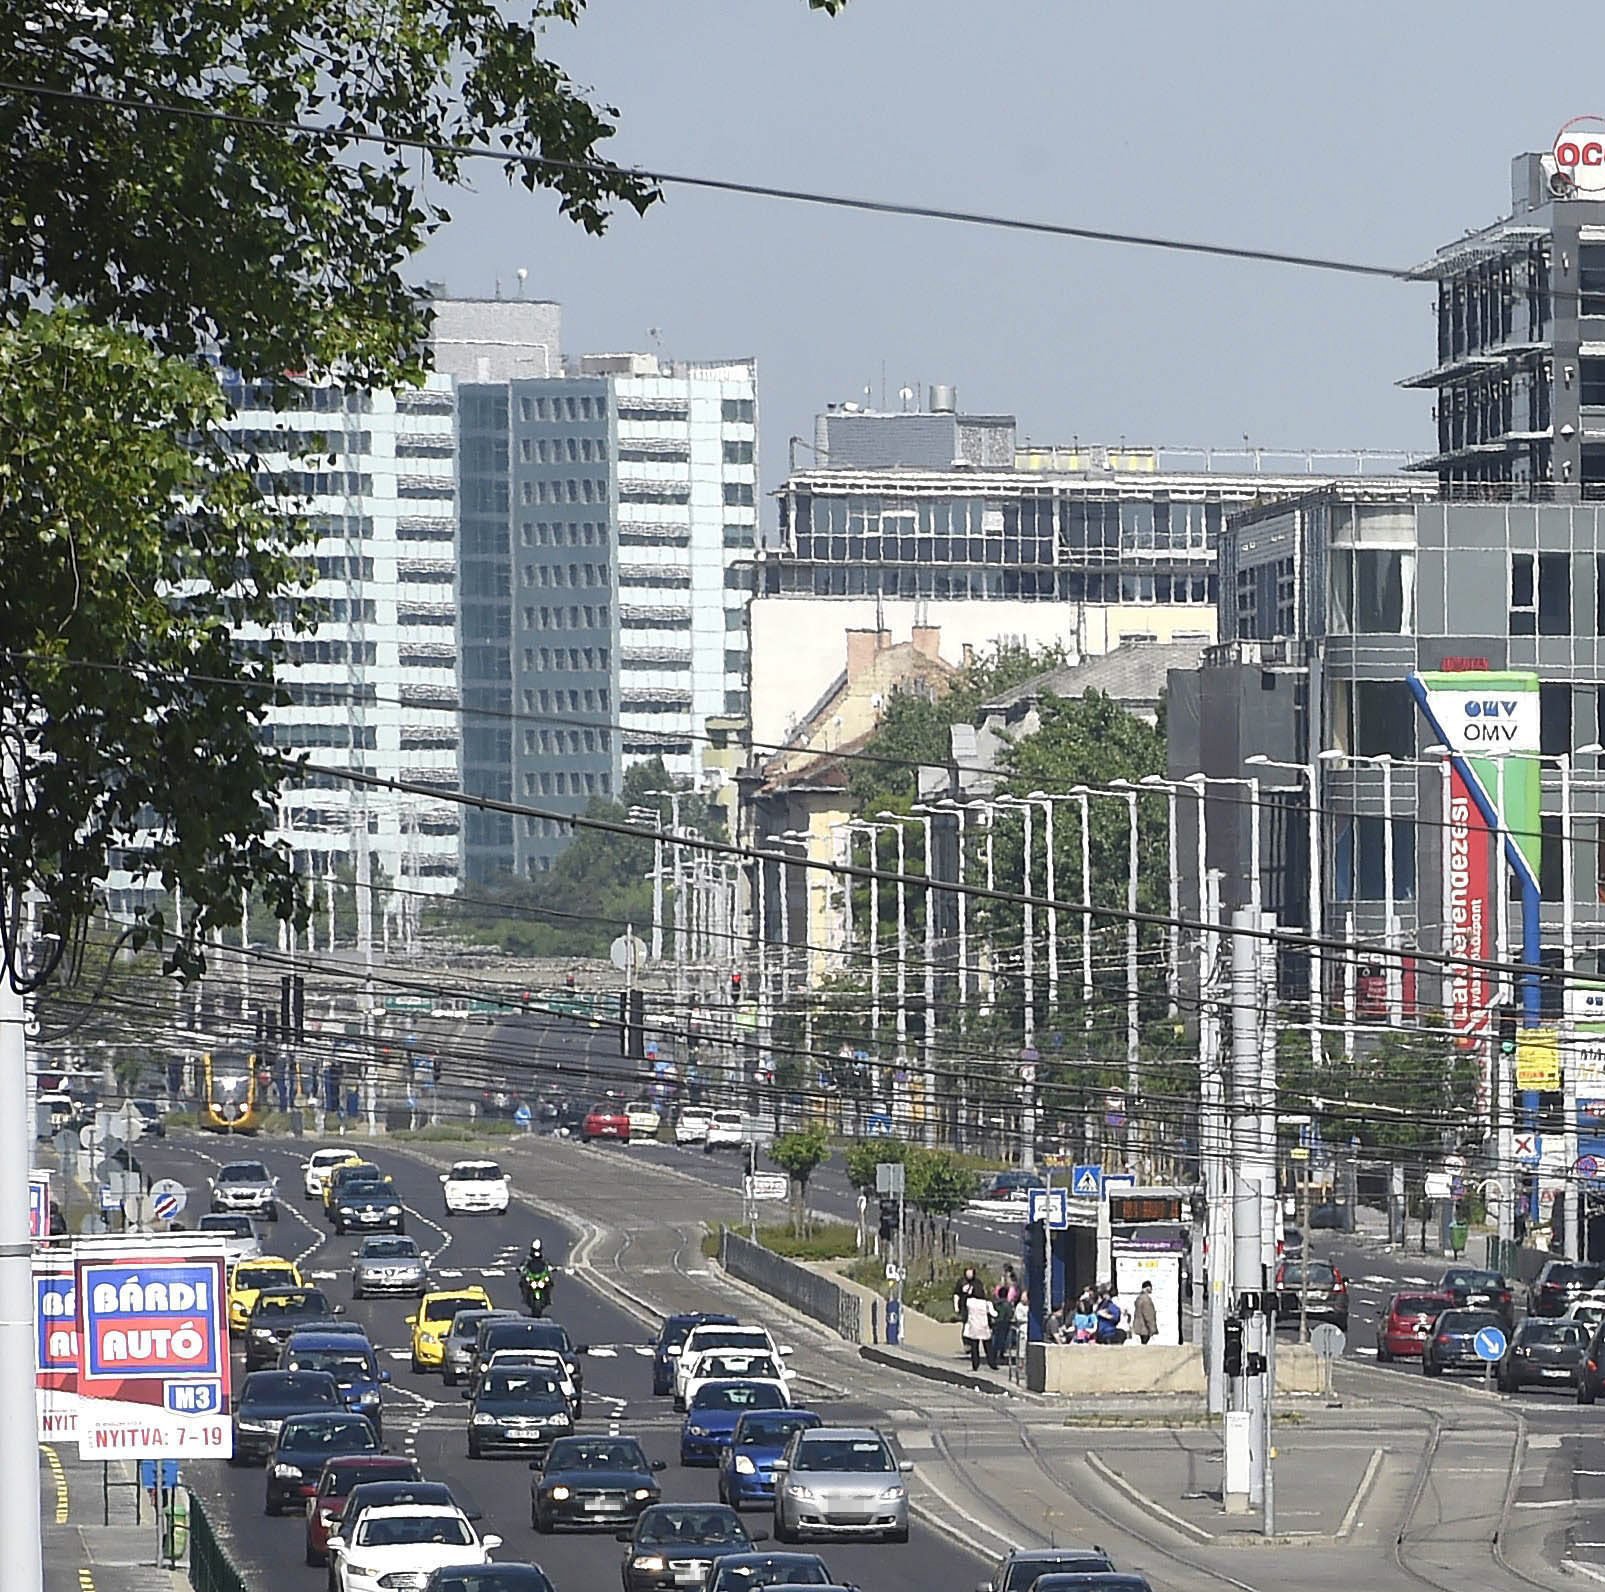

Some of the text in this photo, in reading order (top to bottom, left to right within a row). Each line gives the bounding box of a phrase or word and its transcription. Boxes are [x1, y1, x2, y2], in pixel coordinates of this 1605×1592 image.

[1464, 724, 1518, 740] OMV
[92, 1273, 209, 1313] BÁRDI
[102, 1321, 203, 1361] AUTÓ
[174, 1386, 211, 1409] M3
[42, 1414, 78, 1431] NYIT
[95, 1426, 222, 1448] NYITVA: 7-19
